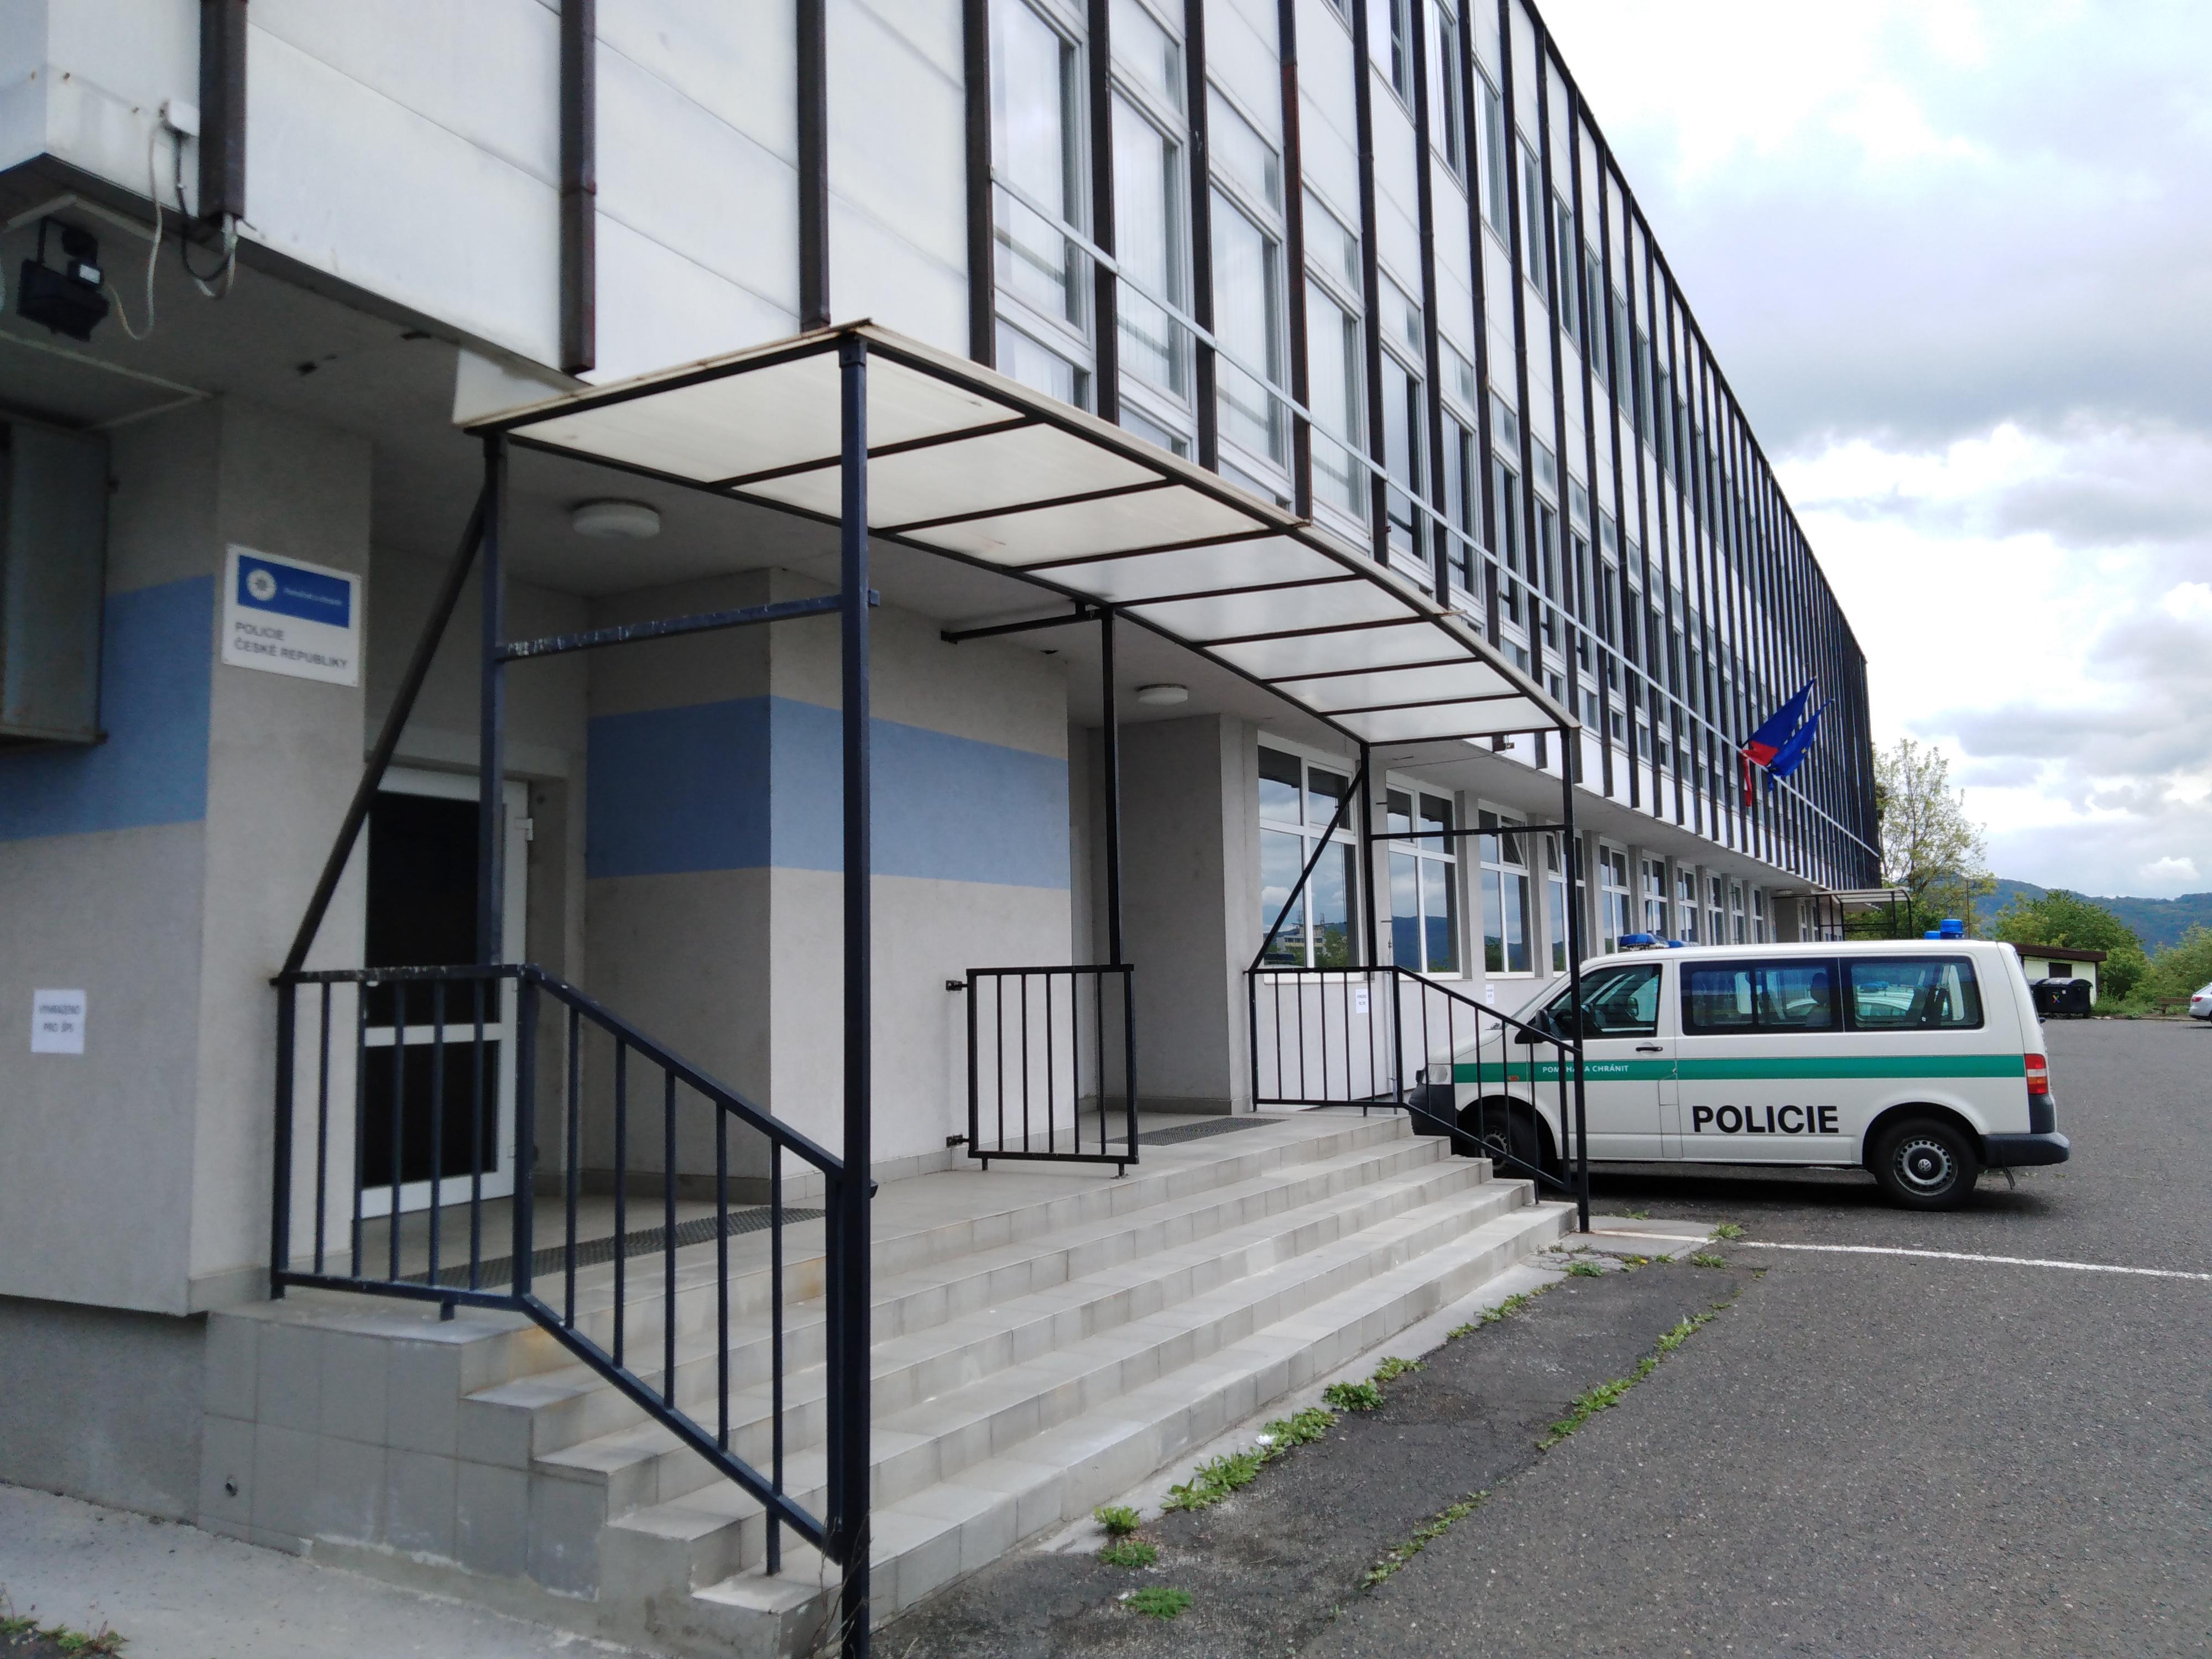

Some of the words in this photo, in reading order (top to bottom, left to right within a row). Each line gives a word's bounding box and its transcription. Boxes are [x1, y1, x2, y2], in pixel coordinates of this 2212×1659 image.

[234, 622, 284, 641] POLICIE
[234, 637, 276, 656] ČESKÉ
[280, 648, 348, 668] REPUBLIKY
[1592, 1063, 1629, 1072] CHRÁNIT
[1692, 1105, 1839, 1134] POLICIE
